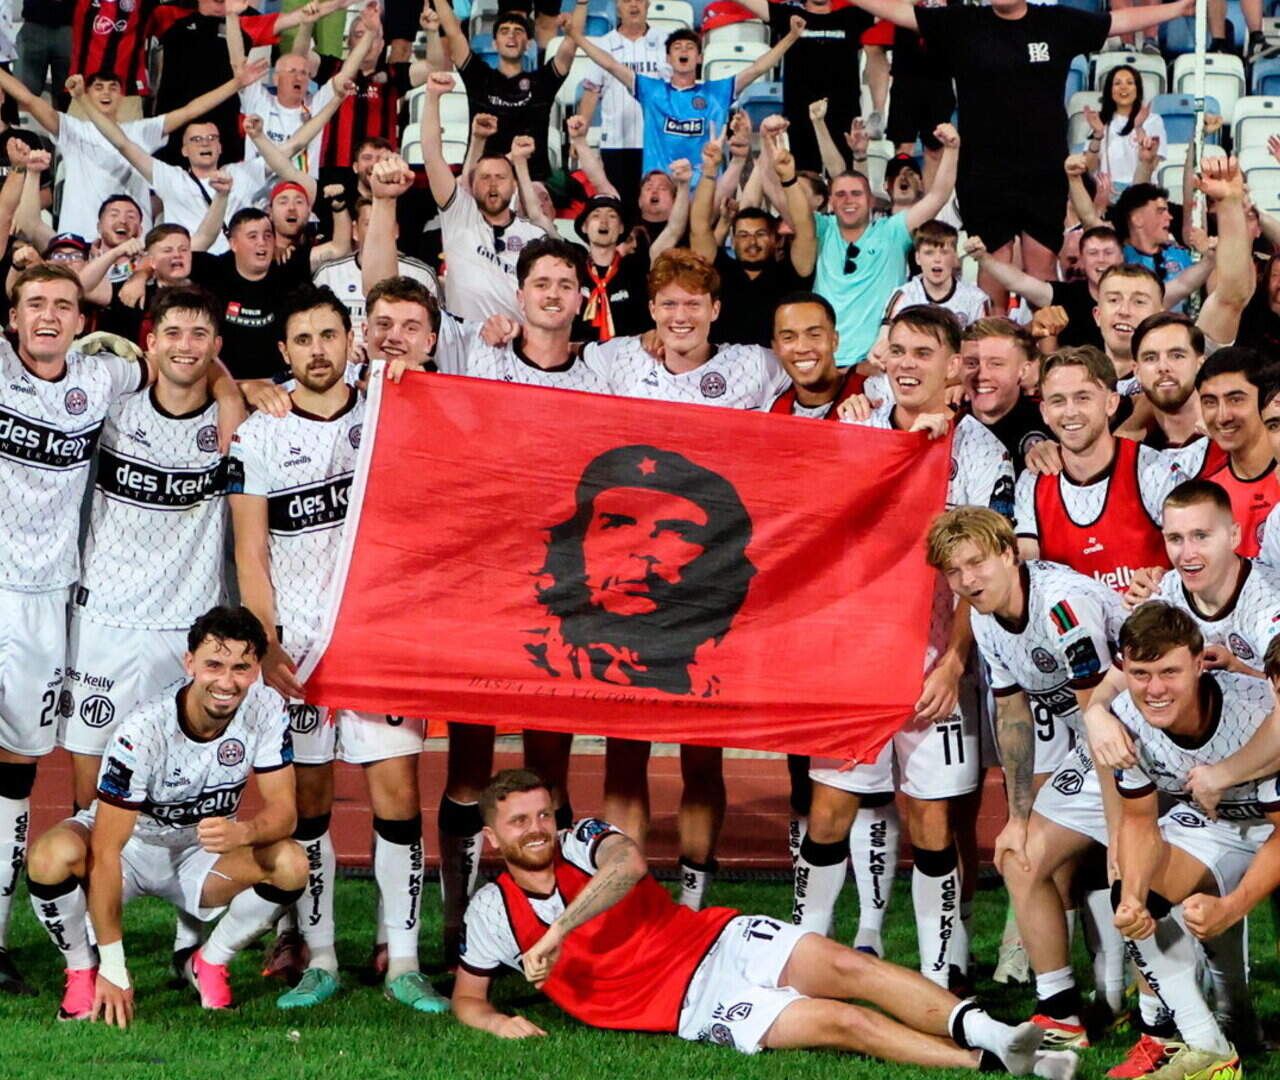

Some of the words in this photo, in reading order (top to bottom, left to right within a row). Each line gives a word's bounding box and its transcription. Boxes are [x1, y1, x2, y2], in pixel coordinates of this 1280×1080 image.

[116, 464, 159, 494] des
[288, 495, 326, 519] des
[83, 673, 115, 693] kelly
[570, 688, 660, 706] VICTORIA
[82, 696, 113, 726] MG
[1033, 703, 1056, 742] 9
[936, 722, 965, 766] 11
[1, 846, 25, 897] kelly
[306, 839, 322, 871] des
[309, 871, 324, 926] kelly
[404, 873, 422, 931] kelly
[941, 875, 956, 912] des
[932, 915, 953, 972] kelly
